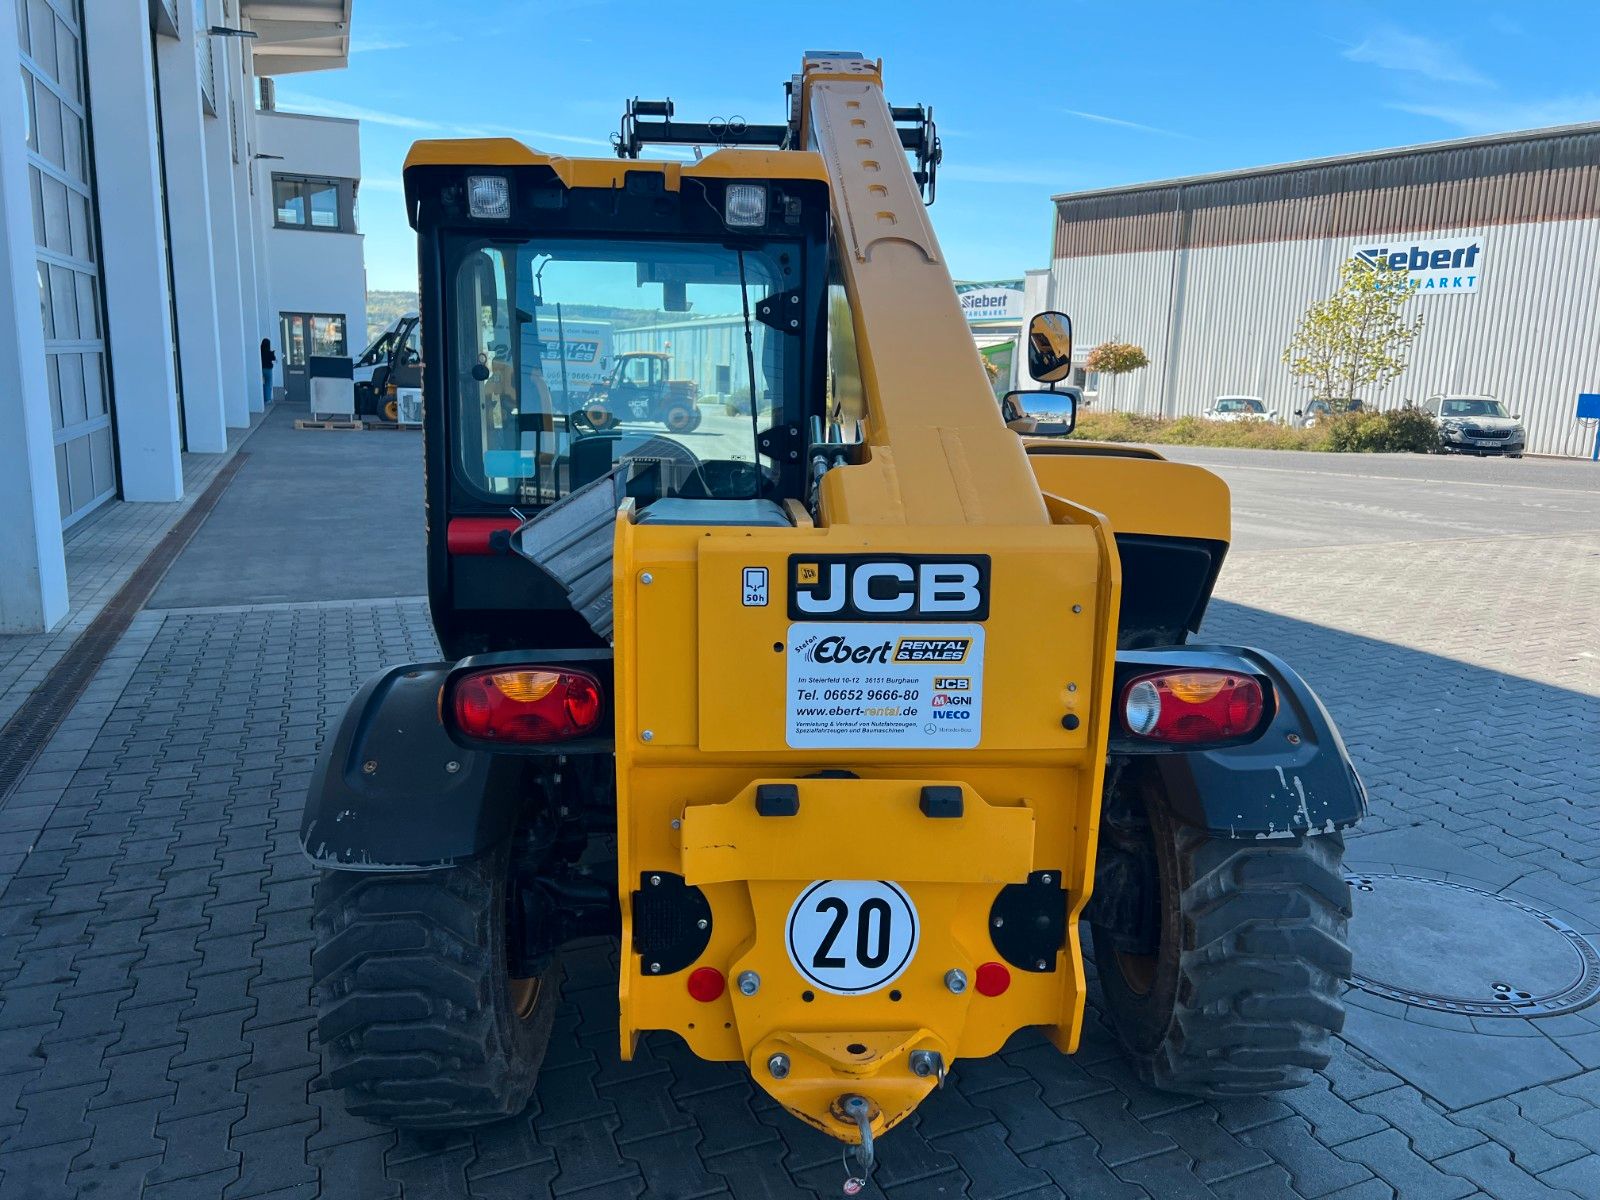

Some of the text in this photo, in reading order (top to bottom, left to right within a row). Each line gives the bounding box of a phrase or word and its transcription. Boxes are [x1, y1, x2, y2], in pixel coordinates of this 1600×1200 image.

[797, 563, 981, 613] JCB
[795, 635, 818, 653] Stefan
[813, 635, 893, 664] Ebert
[900, 641, 965, 650] RENTAL
[896, 651, 963, 660] & SALES
[886, 677, 919, 685] Burghaun
[935, 679, 969, 689] JCB
[797, 689, 919, 701] Tel. 06652 9666-80
[932, 695, 972, 706] MAGNI
[796, 705, 918, 716] www.ebert-rental.de
[933, 710, 971, 720] IVECO
[812, 896, 892, 969] 20
